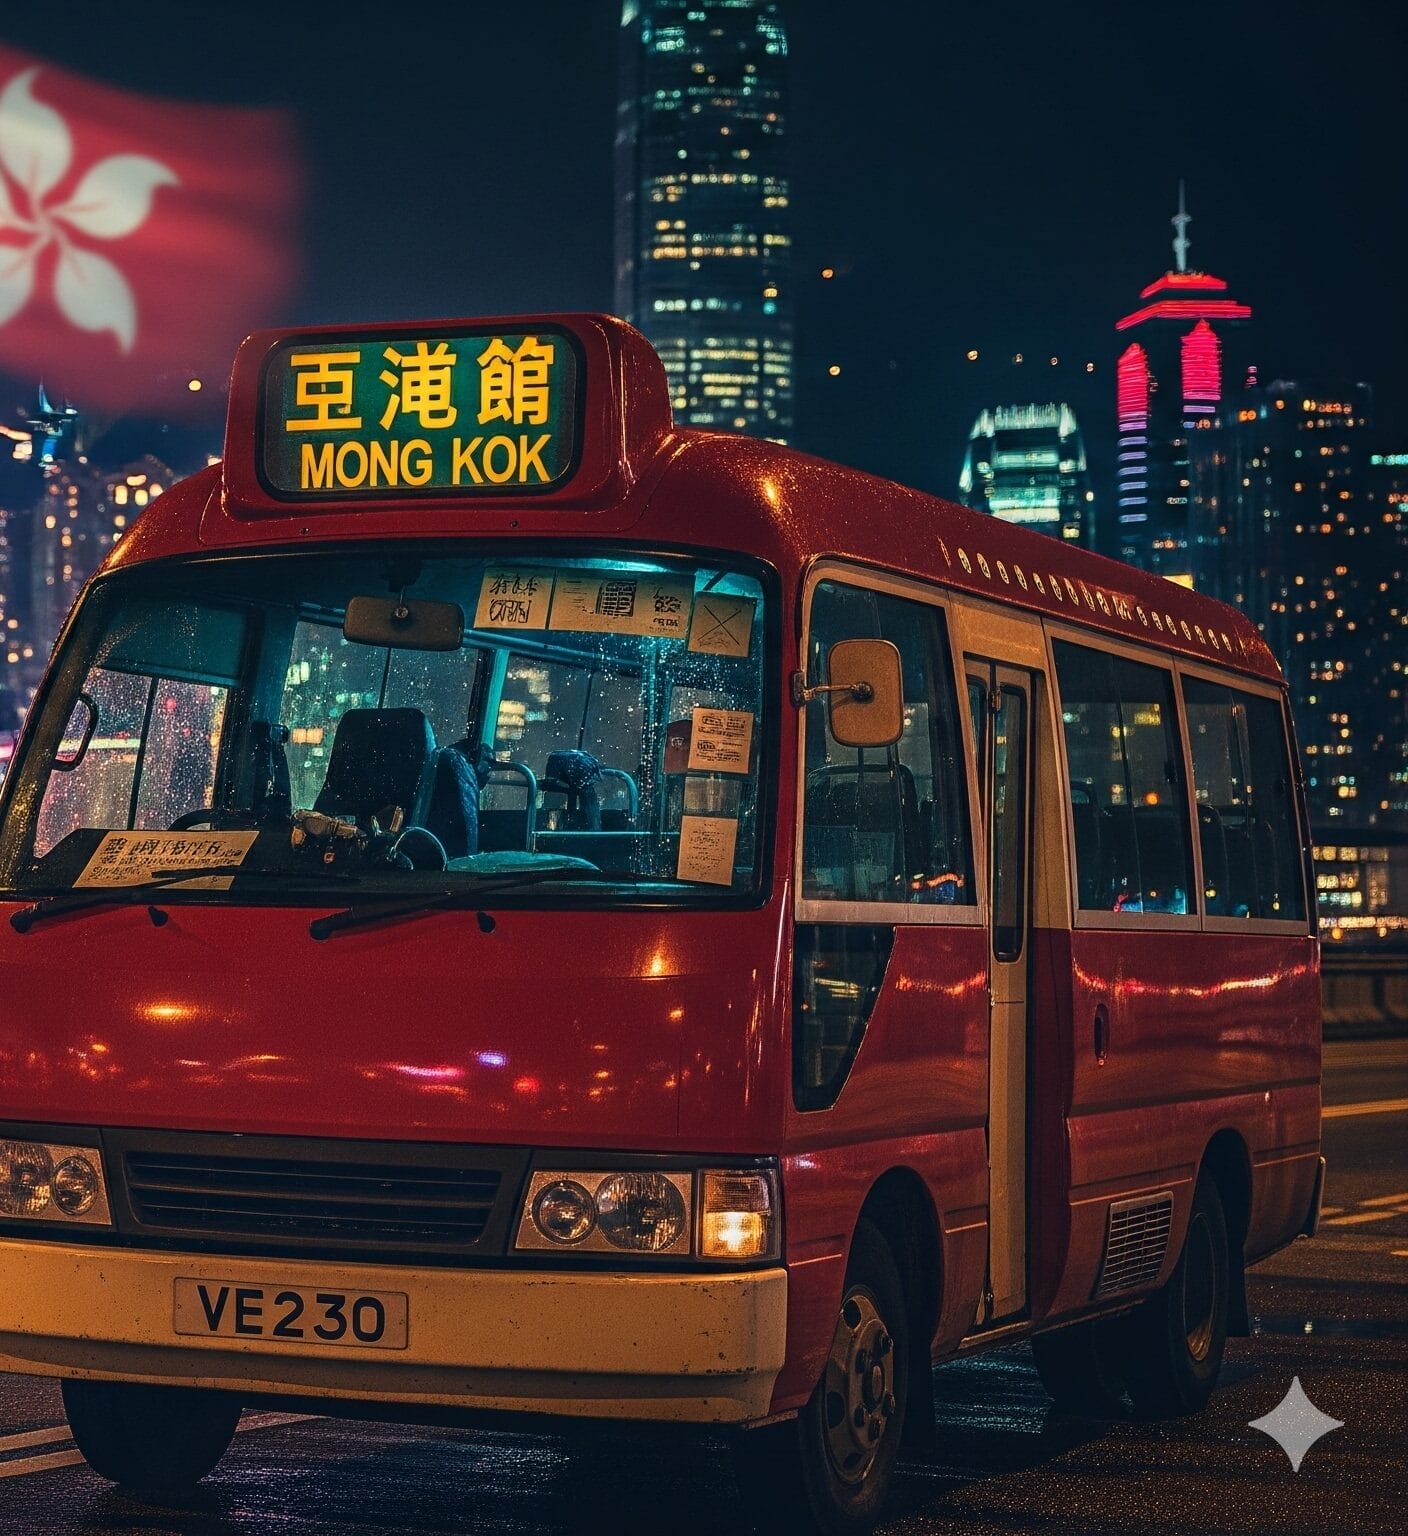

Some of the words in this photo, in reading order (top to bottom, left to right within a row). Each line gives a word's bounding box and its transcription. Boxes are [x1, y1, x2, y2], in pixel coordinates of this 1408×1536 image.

[300, 438, 433, 490] MONG
[451, 433, 552, 486] KOK
[196, 1284, 385, 1343] VE230
